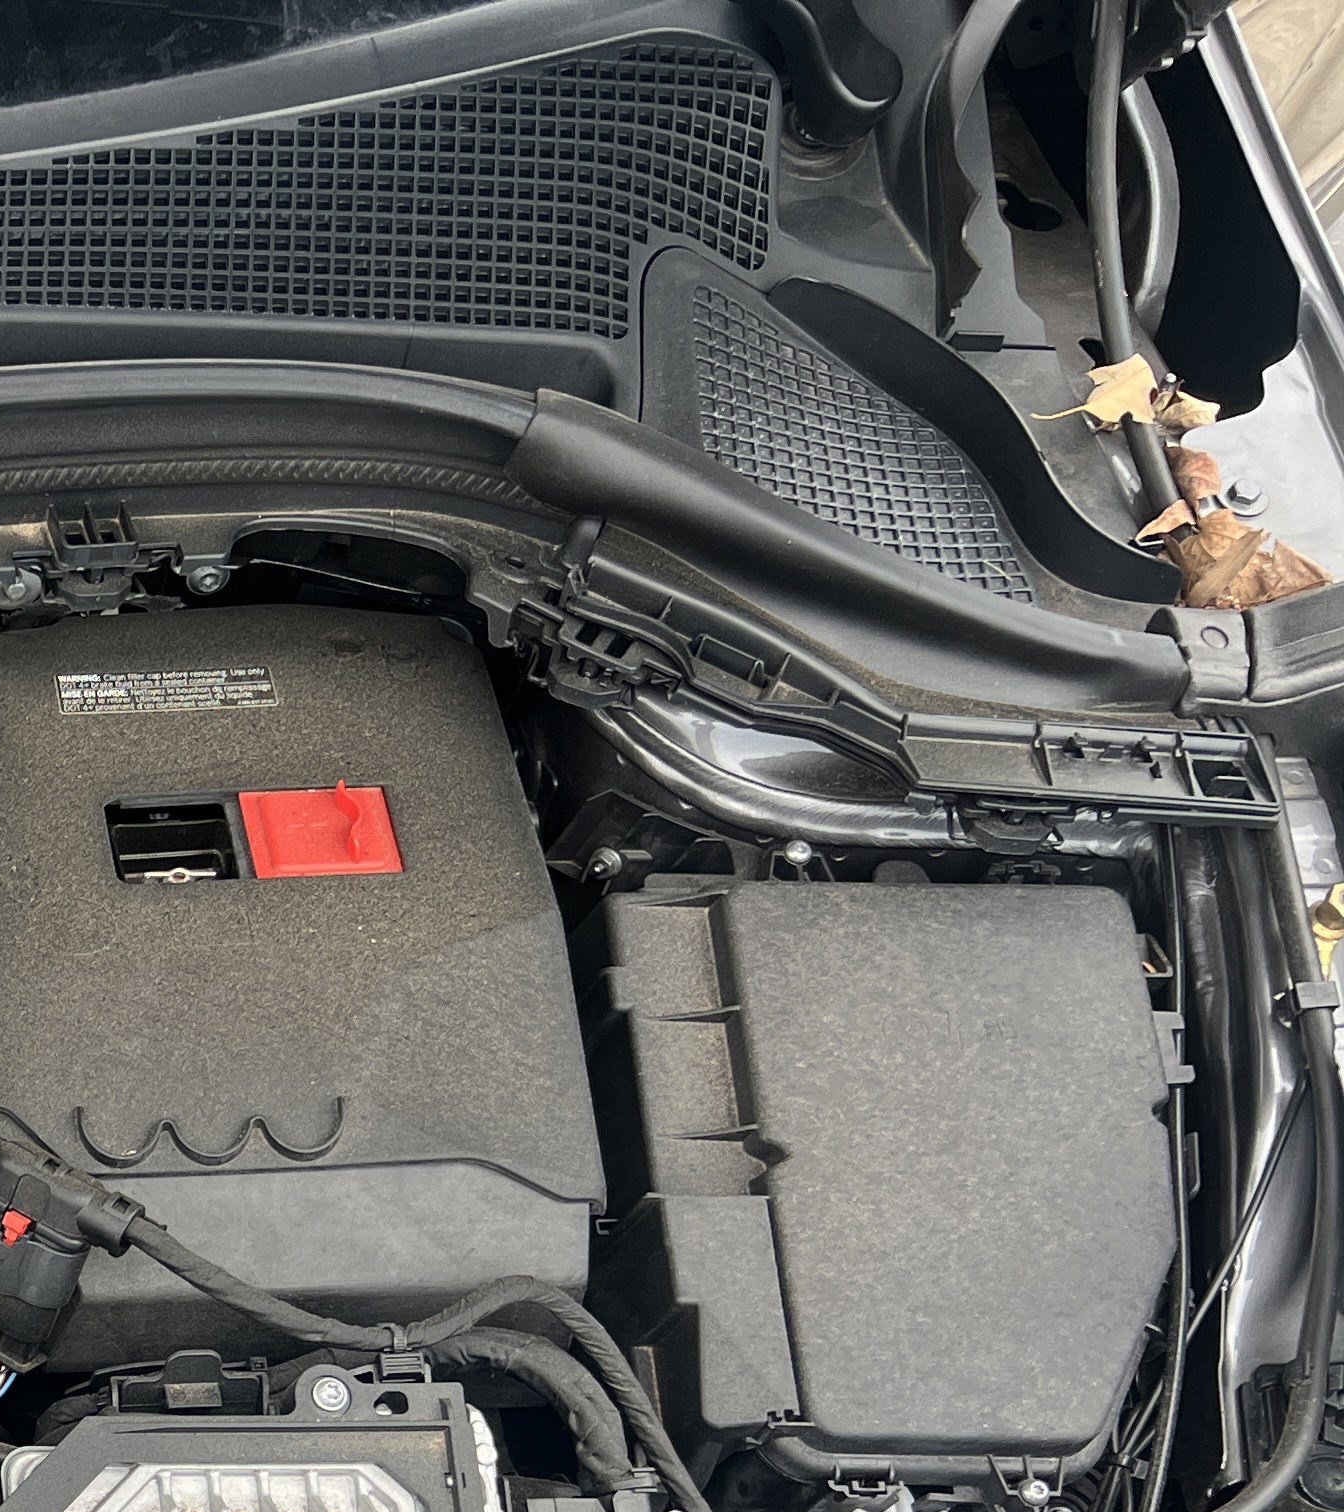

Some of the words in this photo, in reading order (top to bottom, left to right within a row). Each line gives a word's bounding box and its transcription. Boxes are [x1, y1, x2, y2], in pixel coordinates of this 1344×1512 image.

[58, 674, 101, 682] WARNING:
[103, 673, 126, 681] Clean
[163, 671, 188, 679] before
[230, 668, 246, 676] Use
[248, 668, 264, 676] only
[134, 680, 153, 688] from
[162, 679, 187, 687] sealed
[61, 690, 82, 698] MISE
[84, 690, 96, 698] EN
[97, 688, 128, 698] GARDE:
[130, 688, 166, 696] Nettoyez
[176, 686, 211, 694] bouchon
[224, 684, 272, 692] remplissage
[64, 704, 80, 712] DOT
[96, 702, 135, 712] provenant
[156, 700, 196, 709] contenant
